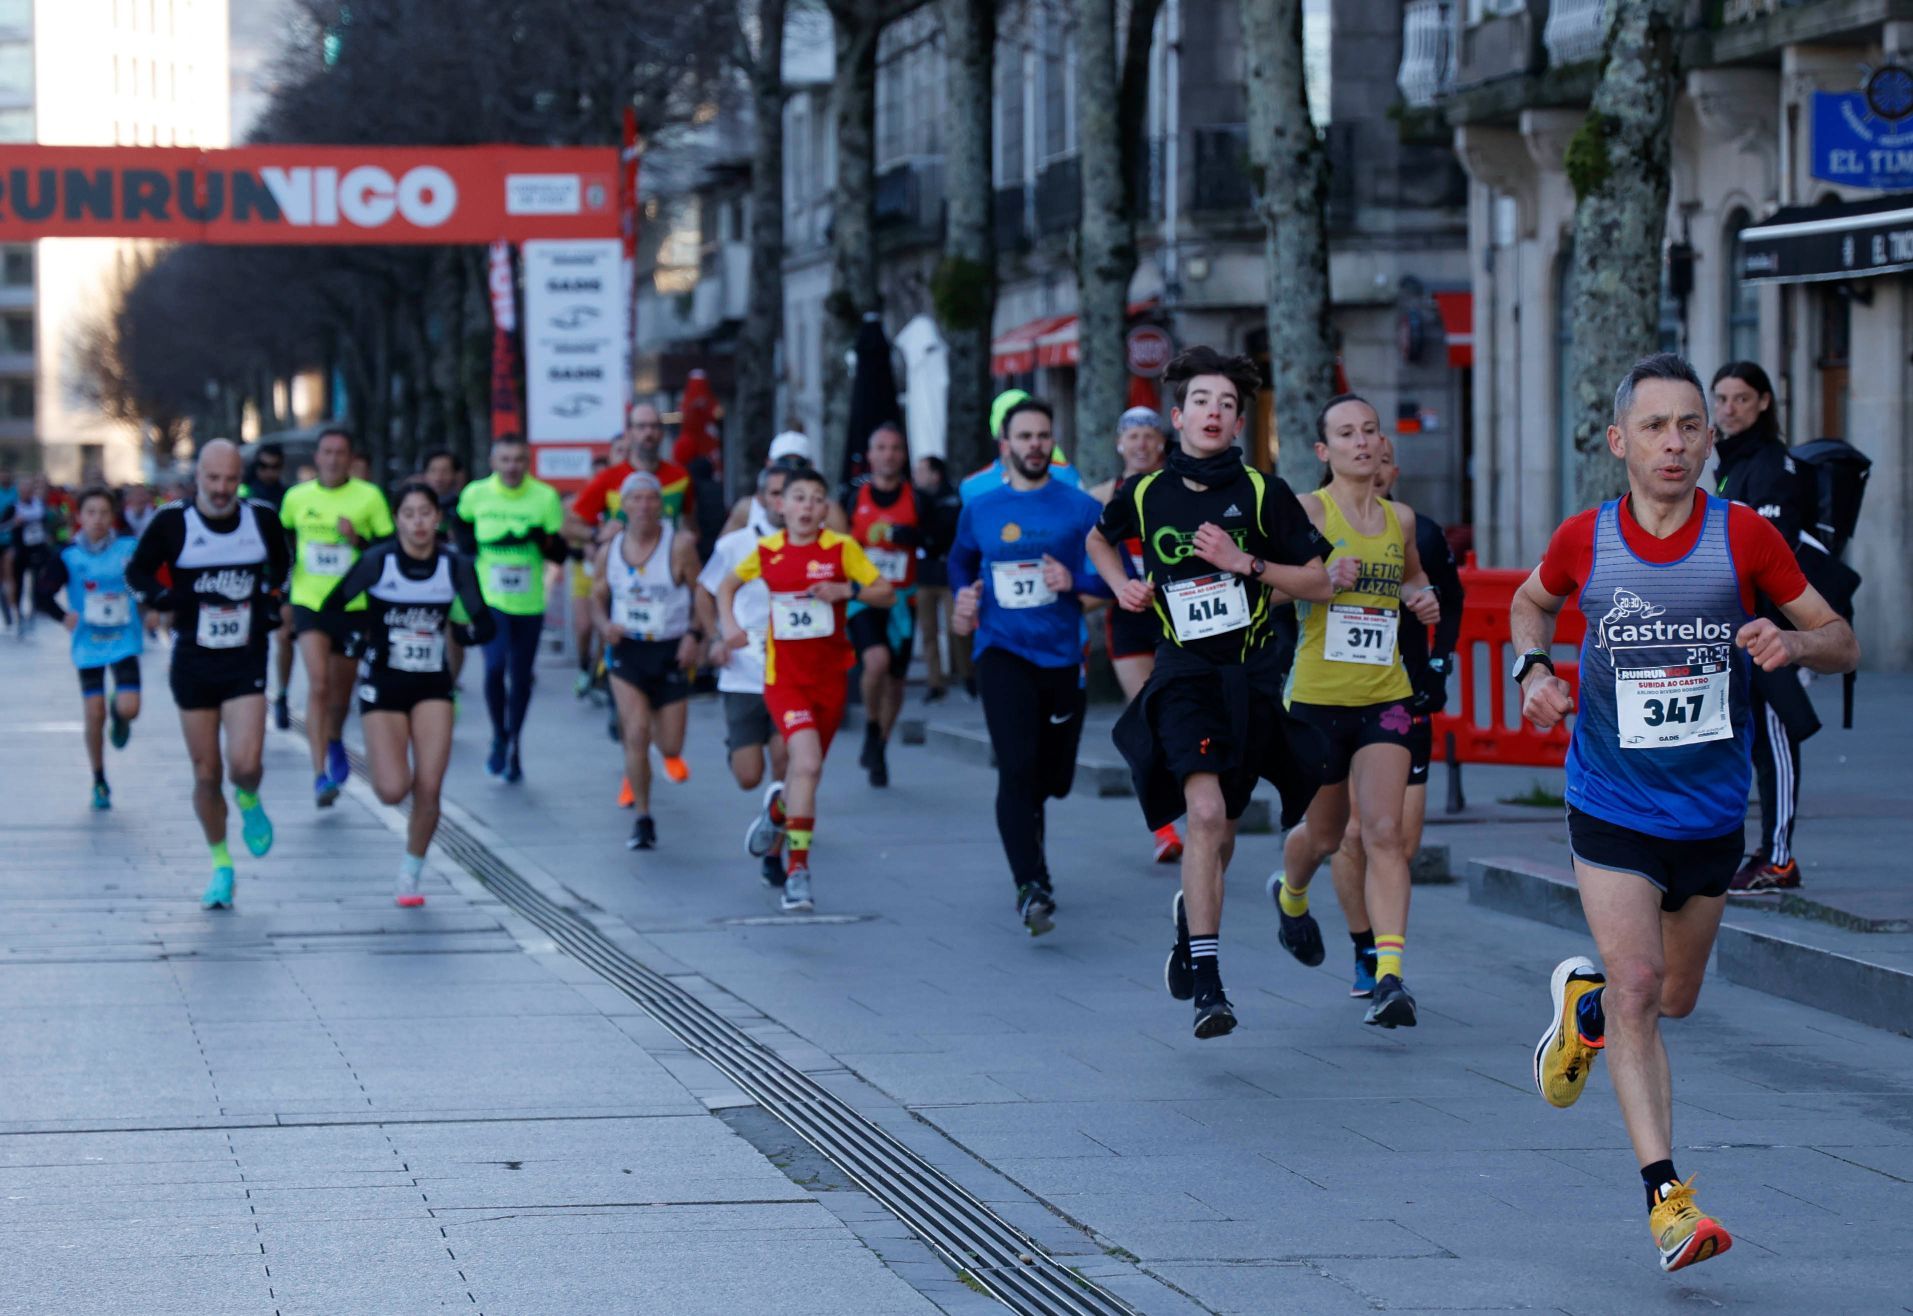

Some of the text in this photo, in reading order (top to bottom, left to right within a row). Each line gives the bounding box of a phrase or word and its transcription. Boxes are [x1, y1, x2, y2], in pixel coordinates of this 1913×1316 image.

[0, 164, 458, 228] UNRUNVIGO
[1013, 580, 1034, 596] 37
[1189, 597, 1228, 622] 414
[1620, 597, 1639, 608] 20:30
[789, 611, 812, 627] 36
[1608, 617, 1731, 642] castrelos
[1347, 627, 1383, 649] 371
[1638, 681, 1666, 689] SUBIDA
[1679, 677, 1709, 687] CASTRO
[1643, 694, 1704, 727] 347
